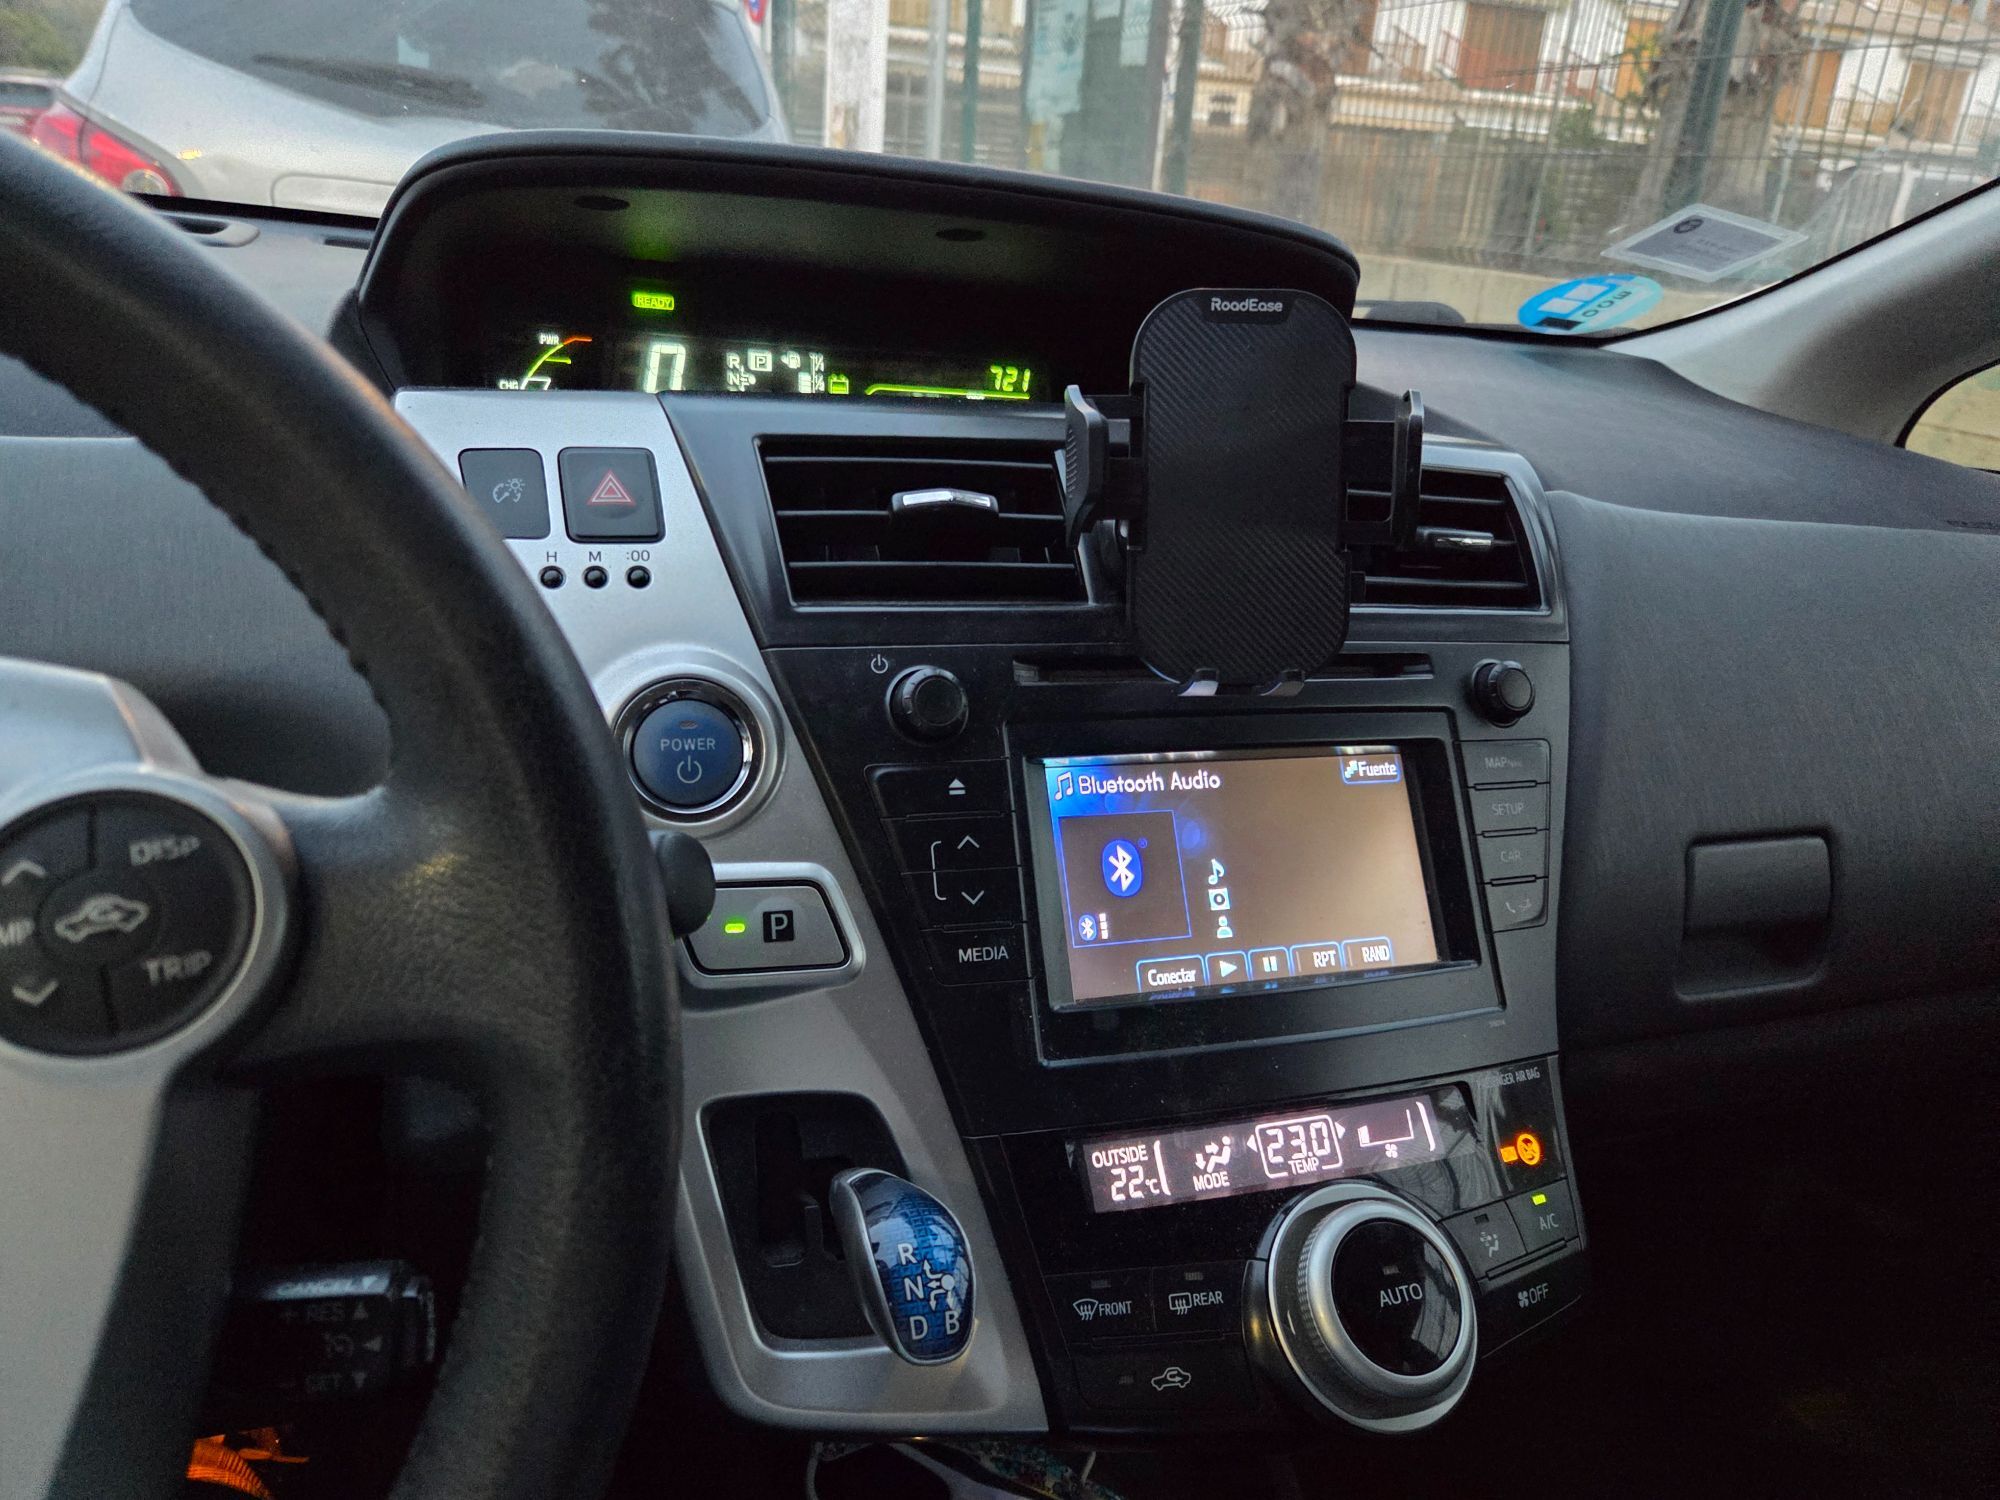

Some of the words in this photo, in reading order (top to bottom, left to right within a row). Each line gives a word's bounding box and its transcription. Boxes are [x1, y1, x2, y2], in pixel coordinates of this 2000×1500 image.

[637, 295, 671, 309] READY
[1210, 298, 1283, 312] RoadEase
[539, 333, 560, 345] PWR
[990, 365, 1030, 393] 721
[546, 552, 558, 562] H
[588, 551, 602, 562] M
[660, 737, 716, 751] POWER
[1358, 761, 1398, 778] Fuente
[1079, 771, 1164, 795] Bluetooth
[1170, 770, 1221, 791] Audio
[1492, 803, 1524, 815] SETUP
[1501, 850, 1522, 863] CAR
[770, 913, 788, 939] P
[958, 945, 1009, 963] MEDIA
[1313, 950, 1336, 968] RPT
[1362, 945, 1390, 963] RAND
[1147, 968, 1197, 986] Conectar
[1266, 1121, 1331, 1163] 23.0
[1092, 1145, 1148, 1169] OUTSIDE
[1287, 1157, 1320, 1175] TEMP
[1193, 1171, 1230, 1191] MODE
[1539, 1212, 1559, 1230] A/C
[897, 1243, 917, 1265] R
[903, 1275, 925, 1301] N
[1379, 1283, 1424, 1308] AUTO
[1529, 1283, 1549, 1304] OFF
[1193, 1291, 1224, 1307] REAR
[1099, 1300, 1133, 1317] FRONT
[909, 1315, 928, 1340] D
[945, 1310, 960, 1335] B
